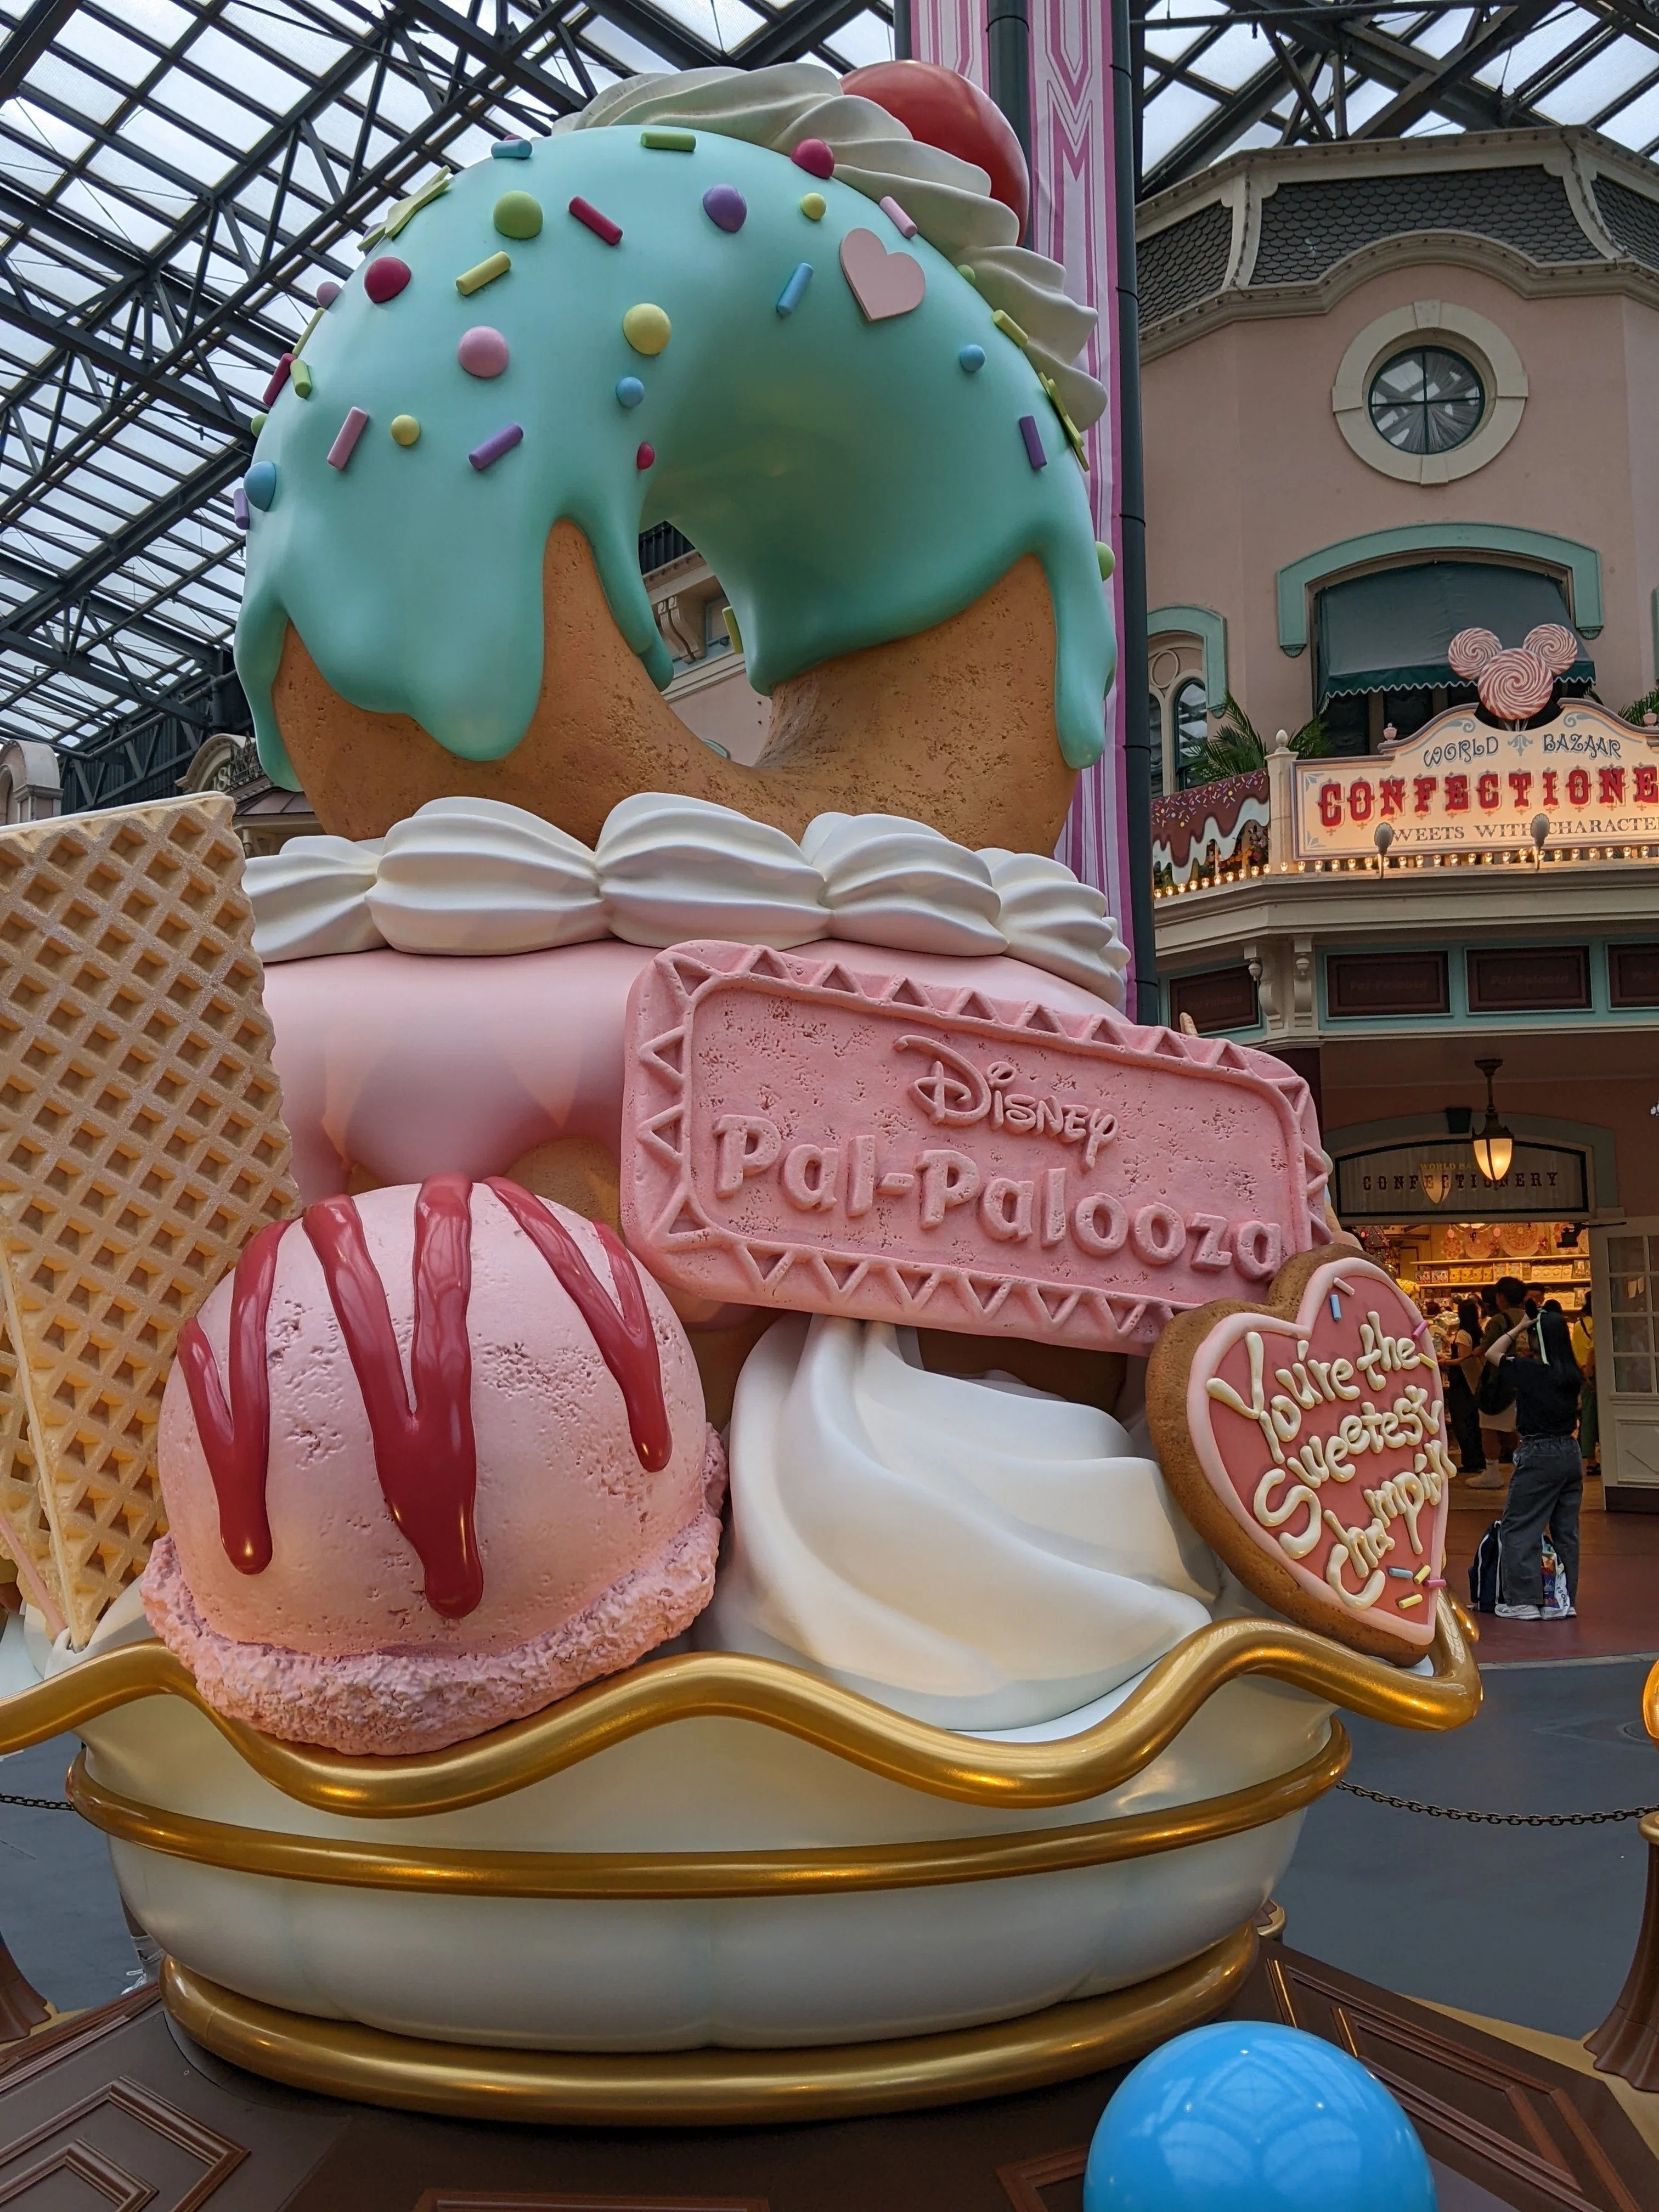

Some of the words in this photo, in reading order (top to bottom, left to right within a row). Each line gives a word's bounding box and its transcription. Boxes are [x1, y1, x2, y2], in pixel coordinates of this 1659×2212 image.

[1423, 736, 1499, 768] WORLD
[1542, 732, 1622, 760] BAZAAR
[1392, 825, 1465, 842] WEETS
[1548, 816, 1659, 835] CHARACTE
[712, 1113, 1283, 1282] Pal-Palooza
[1205, 1331, 1361, 1465] You're
[1356, 1310, 1421, 1391] the
[1253, 1384, 1443, 1560] Sweetest
